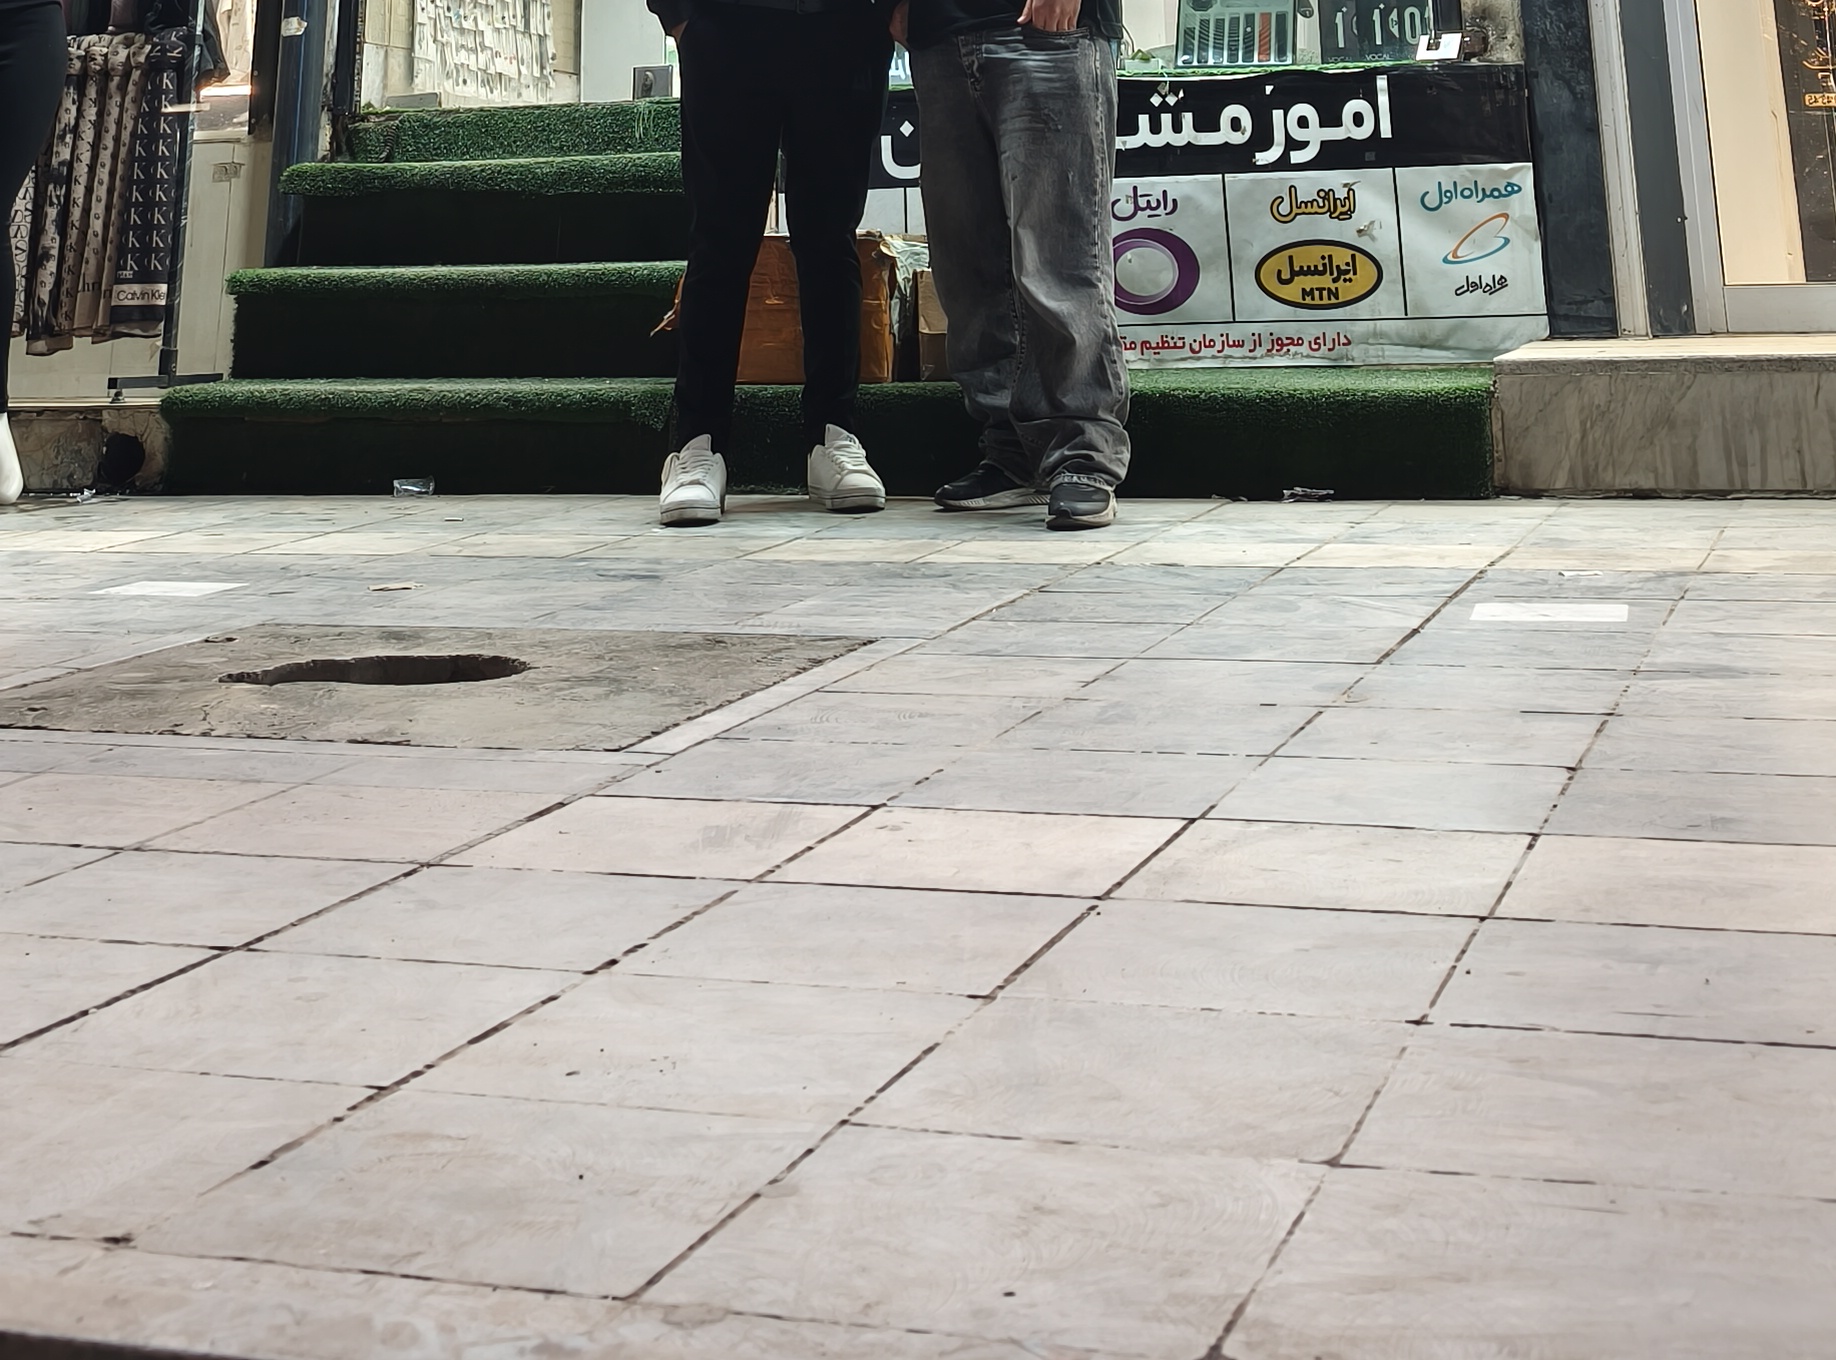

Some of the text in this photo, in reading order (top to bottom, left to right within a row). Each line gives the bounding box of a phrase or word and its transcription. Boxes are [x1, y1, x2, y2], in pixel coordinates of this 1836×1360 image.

[1111, 185, 1179, 222] رایتل
[1270, 184, 1357, 224] ایرانسل
[1420, 180, 1522, 212] همراه اول
[1276, 254, 1358, 285] ایرانسل
[1301, 286, 1340, 302] MTN
[1140, 333, 1186, 356] تنظیم
[1189, 332, 1245, 355] سازمان
[1249, 333, 1262, 354] از
[1266, 332, 1304, 354] مجوز
[1307, 332, 1352, 353] دارای
